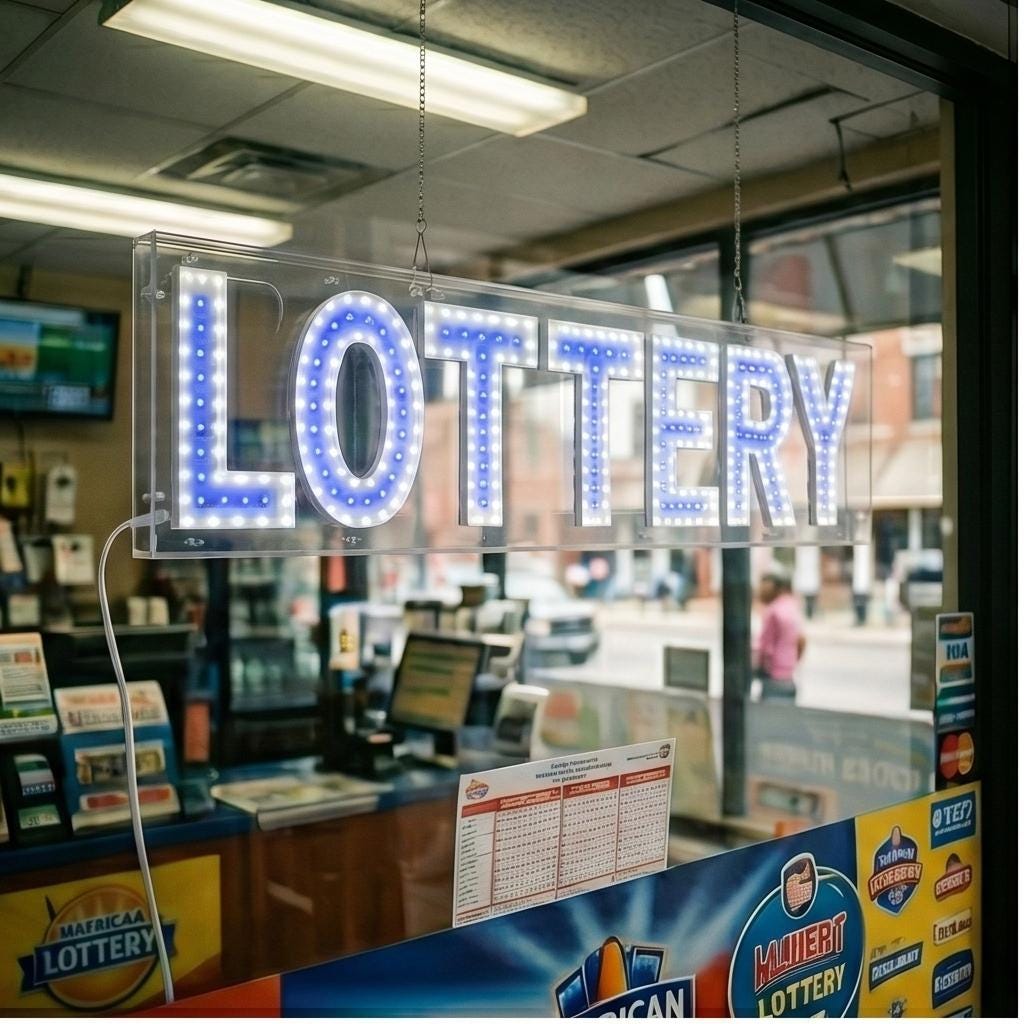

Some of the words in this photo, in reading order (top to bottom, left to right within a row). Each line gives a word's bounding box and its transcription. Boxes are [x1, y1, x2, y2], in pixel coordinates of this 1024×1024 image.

[171, 265, 856, 528] LOTTERY
[42, 928, 156, 975] LOTTERY
[758, 962, 846, 1018] LOTTERY
